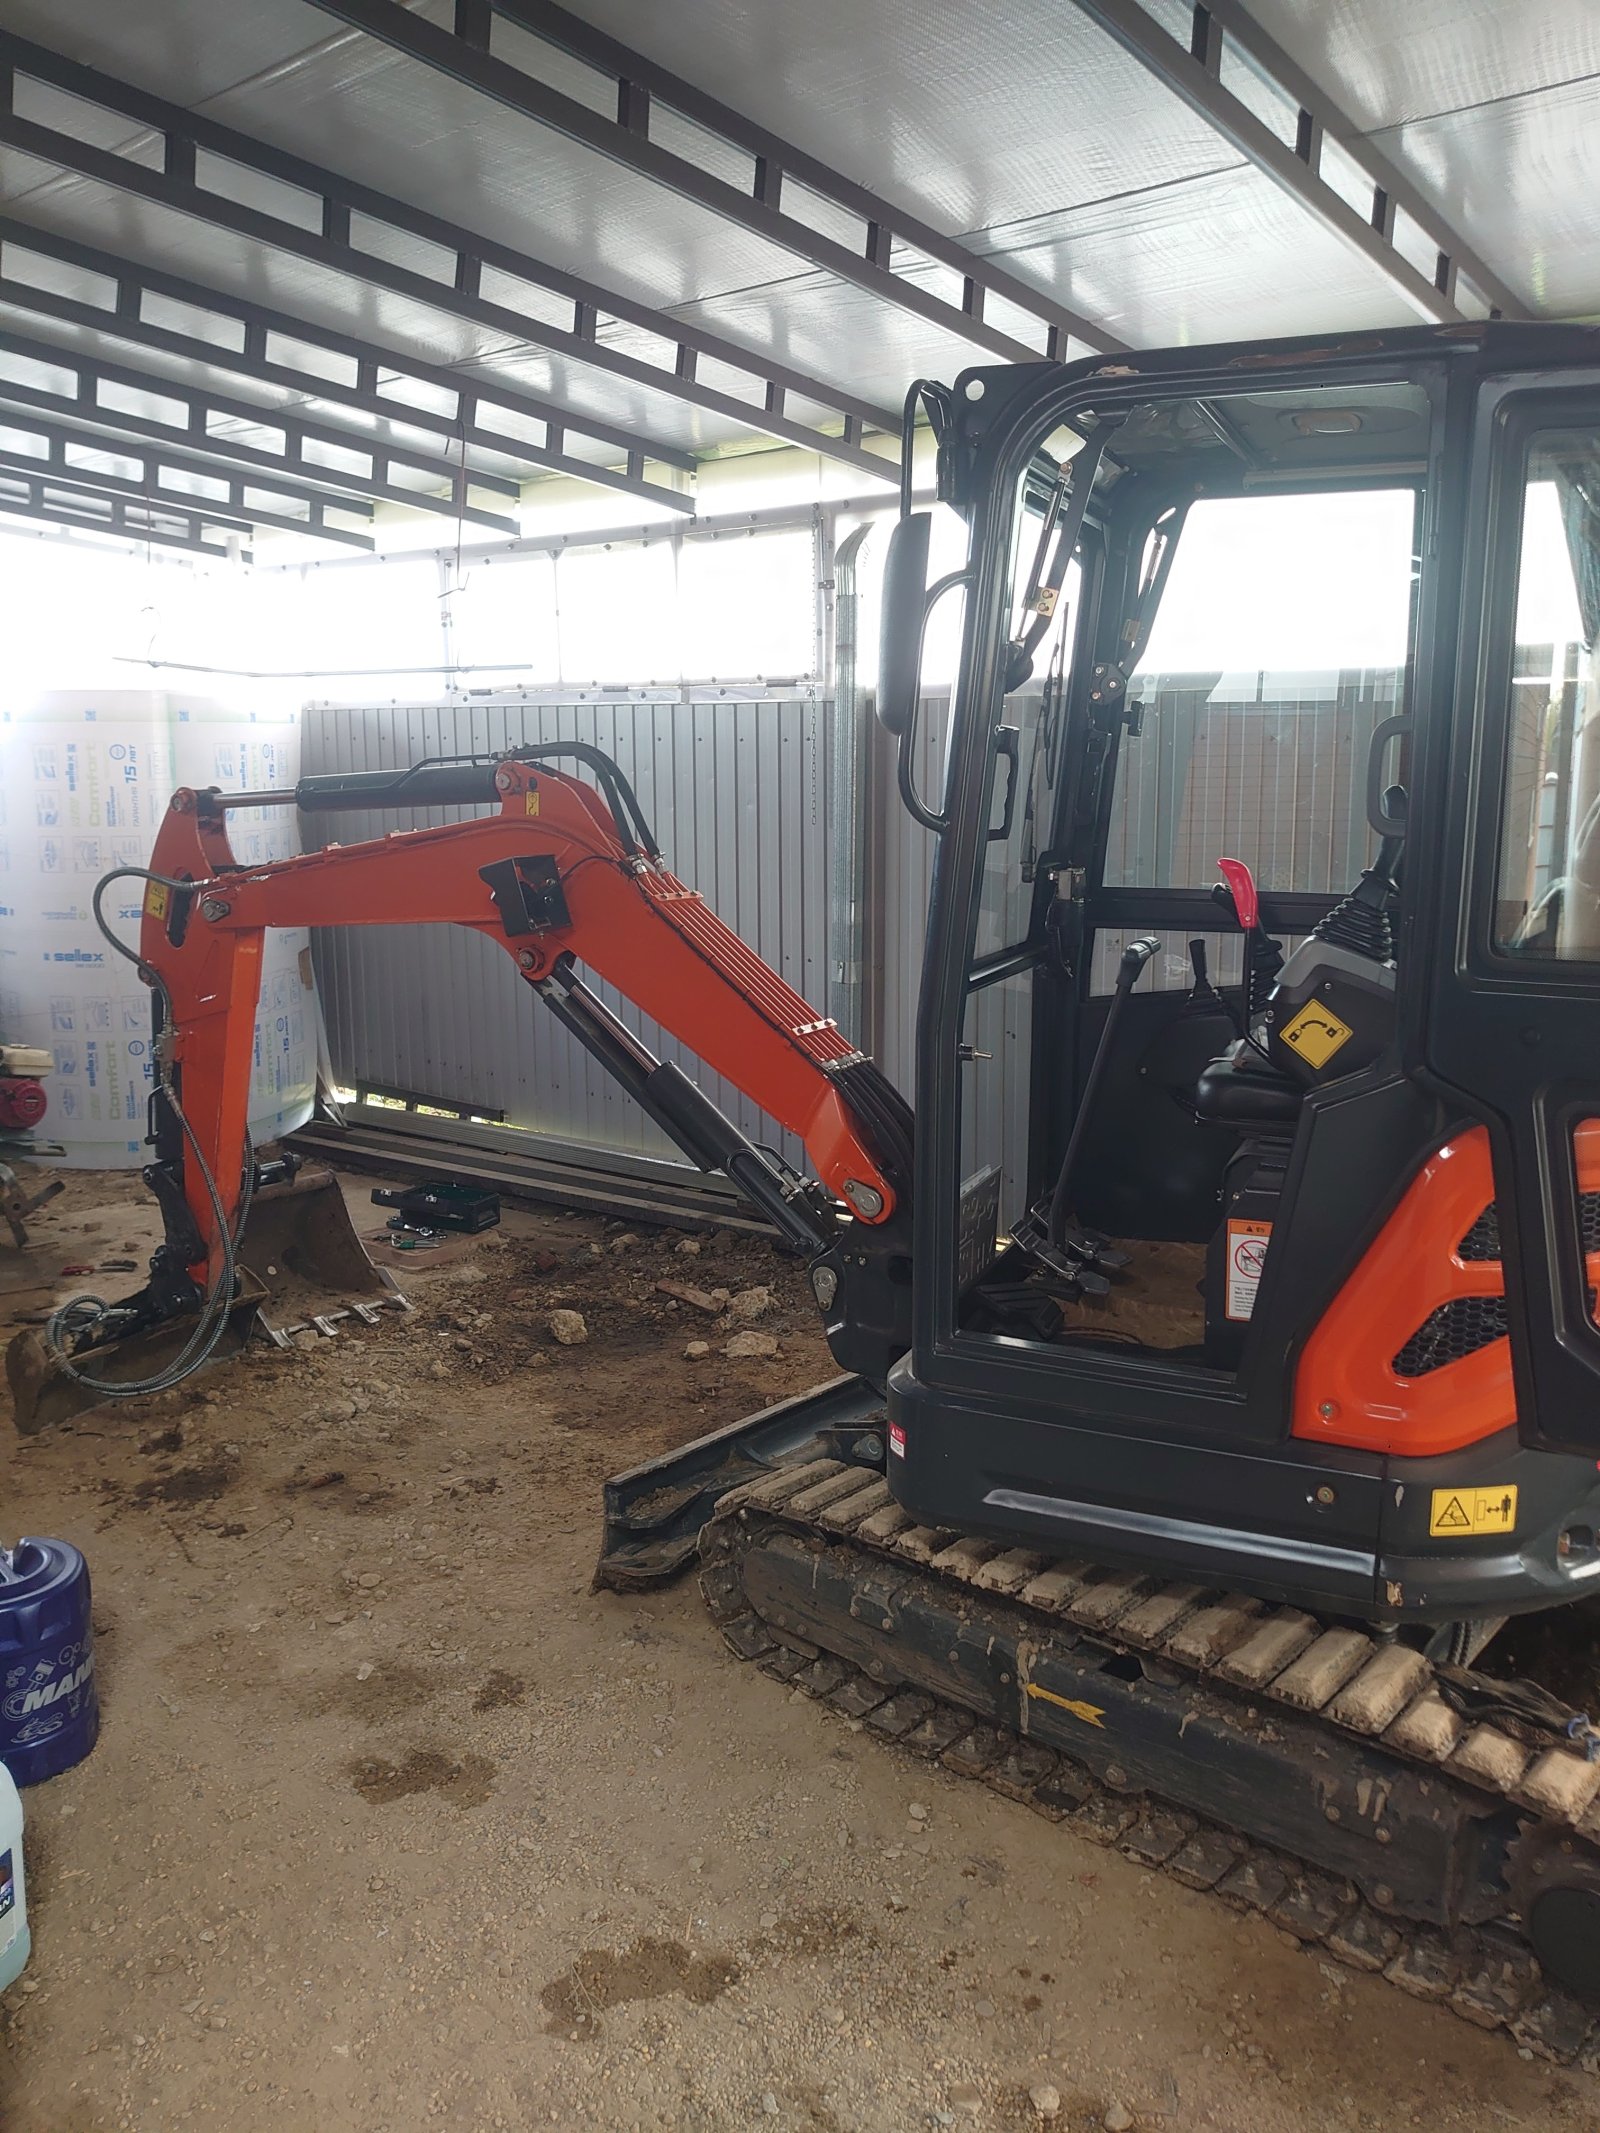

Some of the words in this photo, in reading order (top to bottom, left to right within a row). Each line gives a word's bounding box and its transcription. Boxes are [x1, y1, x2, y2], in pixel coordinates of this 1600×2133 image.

[123, 765, 138, 784] 15
[54, 948, 104, 962] sellex
[105, 1040, 121, 1120] Comfort
